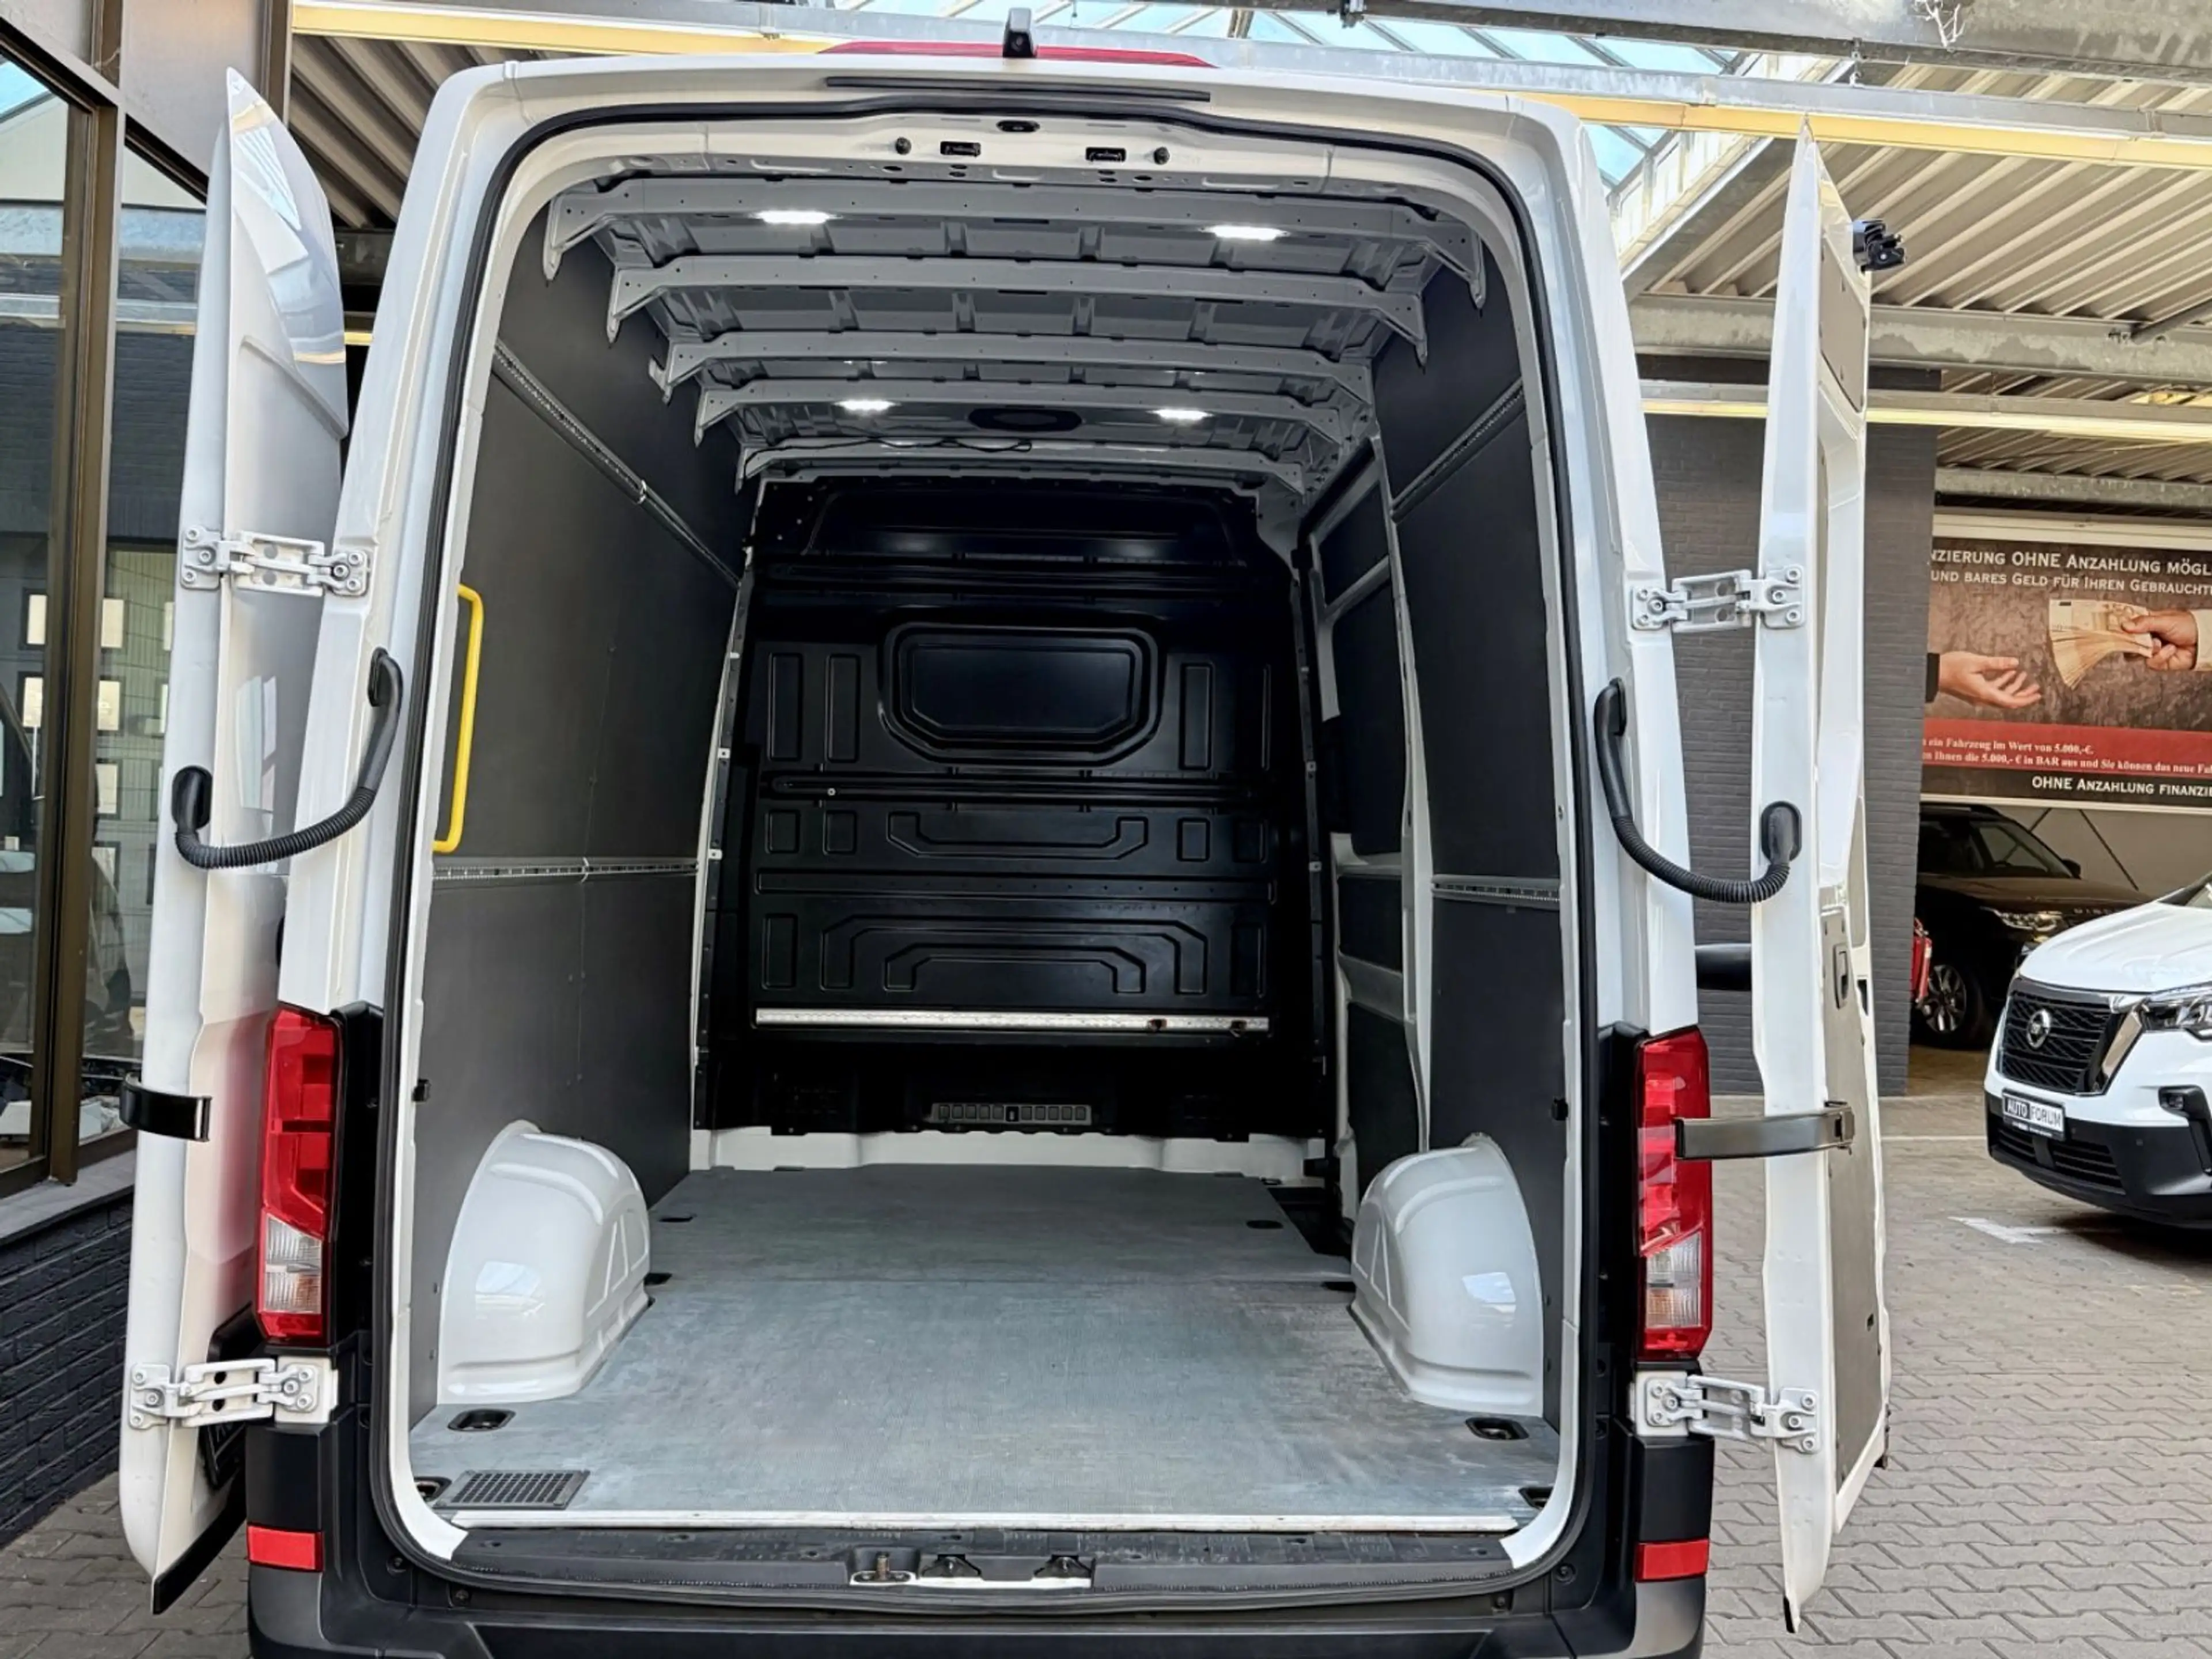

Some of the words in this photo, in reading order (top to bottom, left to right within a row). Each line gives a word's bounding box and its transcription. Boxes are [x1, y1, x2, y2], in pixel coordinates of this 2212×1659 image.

[2012, 551, 2061, 567] OHNE
[2066, 554, 2161, 574] ANZAHLUNG
[1931, 570, 1959, 582] UND
[1964, 571, 2007, 584] BARES
[2012, 572, 2048, 586] GELD
[2054, 573, 2079, 589] FÜR
[2084, 577, 2124, 591] IHREN
[1946, 738, 1992, 751] Fahrzeug
[2009, 741, 2032, 752] Wert
[2035, 744, 2052, 753] von
[1934, 750, 1962, 761] Ihnen
[1964, 752, 1979, 762] die
[2036, 755, 2059, 766] BAR
[2080, 758, 2098, 768] und
[2118, 760, 2152, 771] können
[2032, 775, 2073, 790] OHNE
[2076, 778, 2154, 794] ANZAHLUNG
[2007, 1098, 2028, 1119] AUTO
[2030, 1105, 2062, 1128] FORUM
